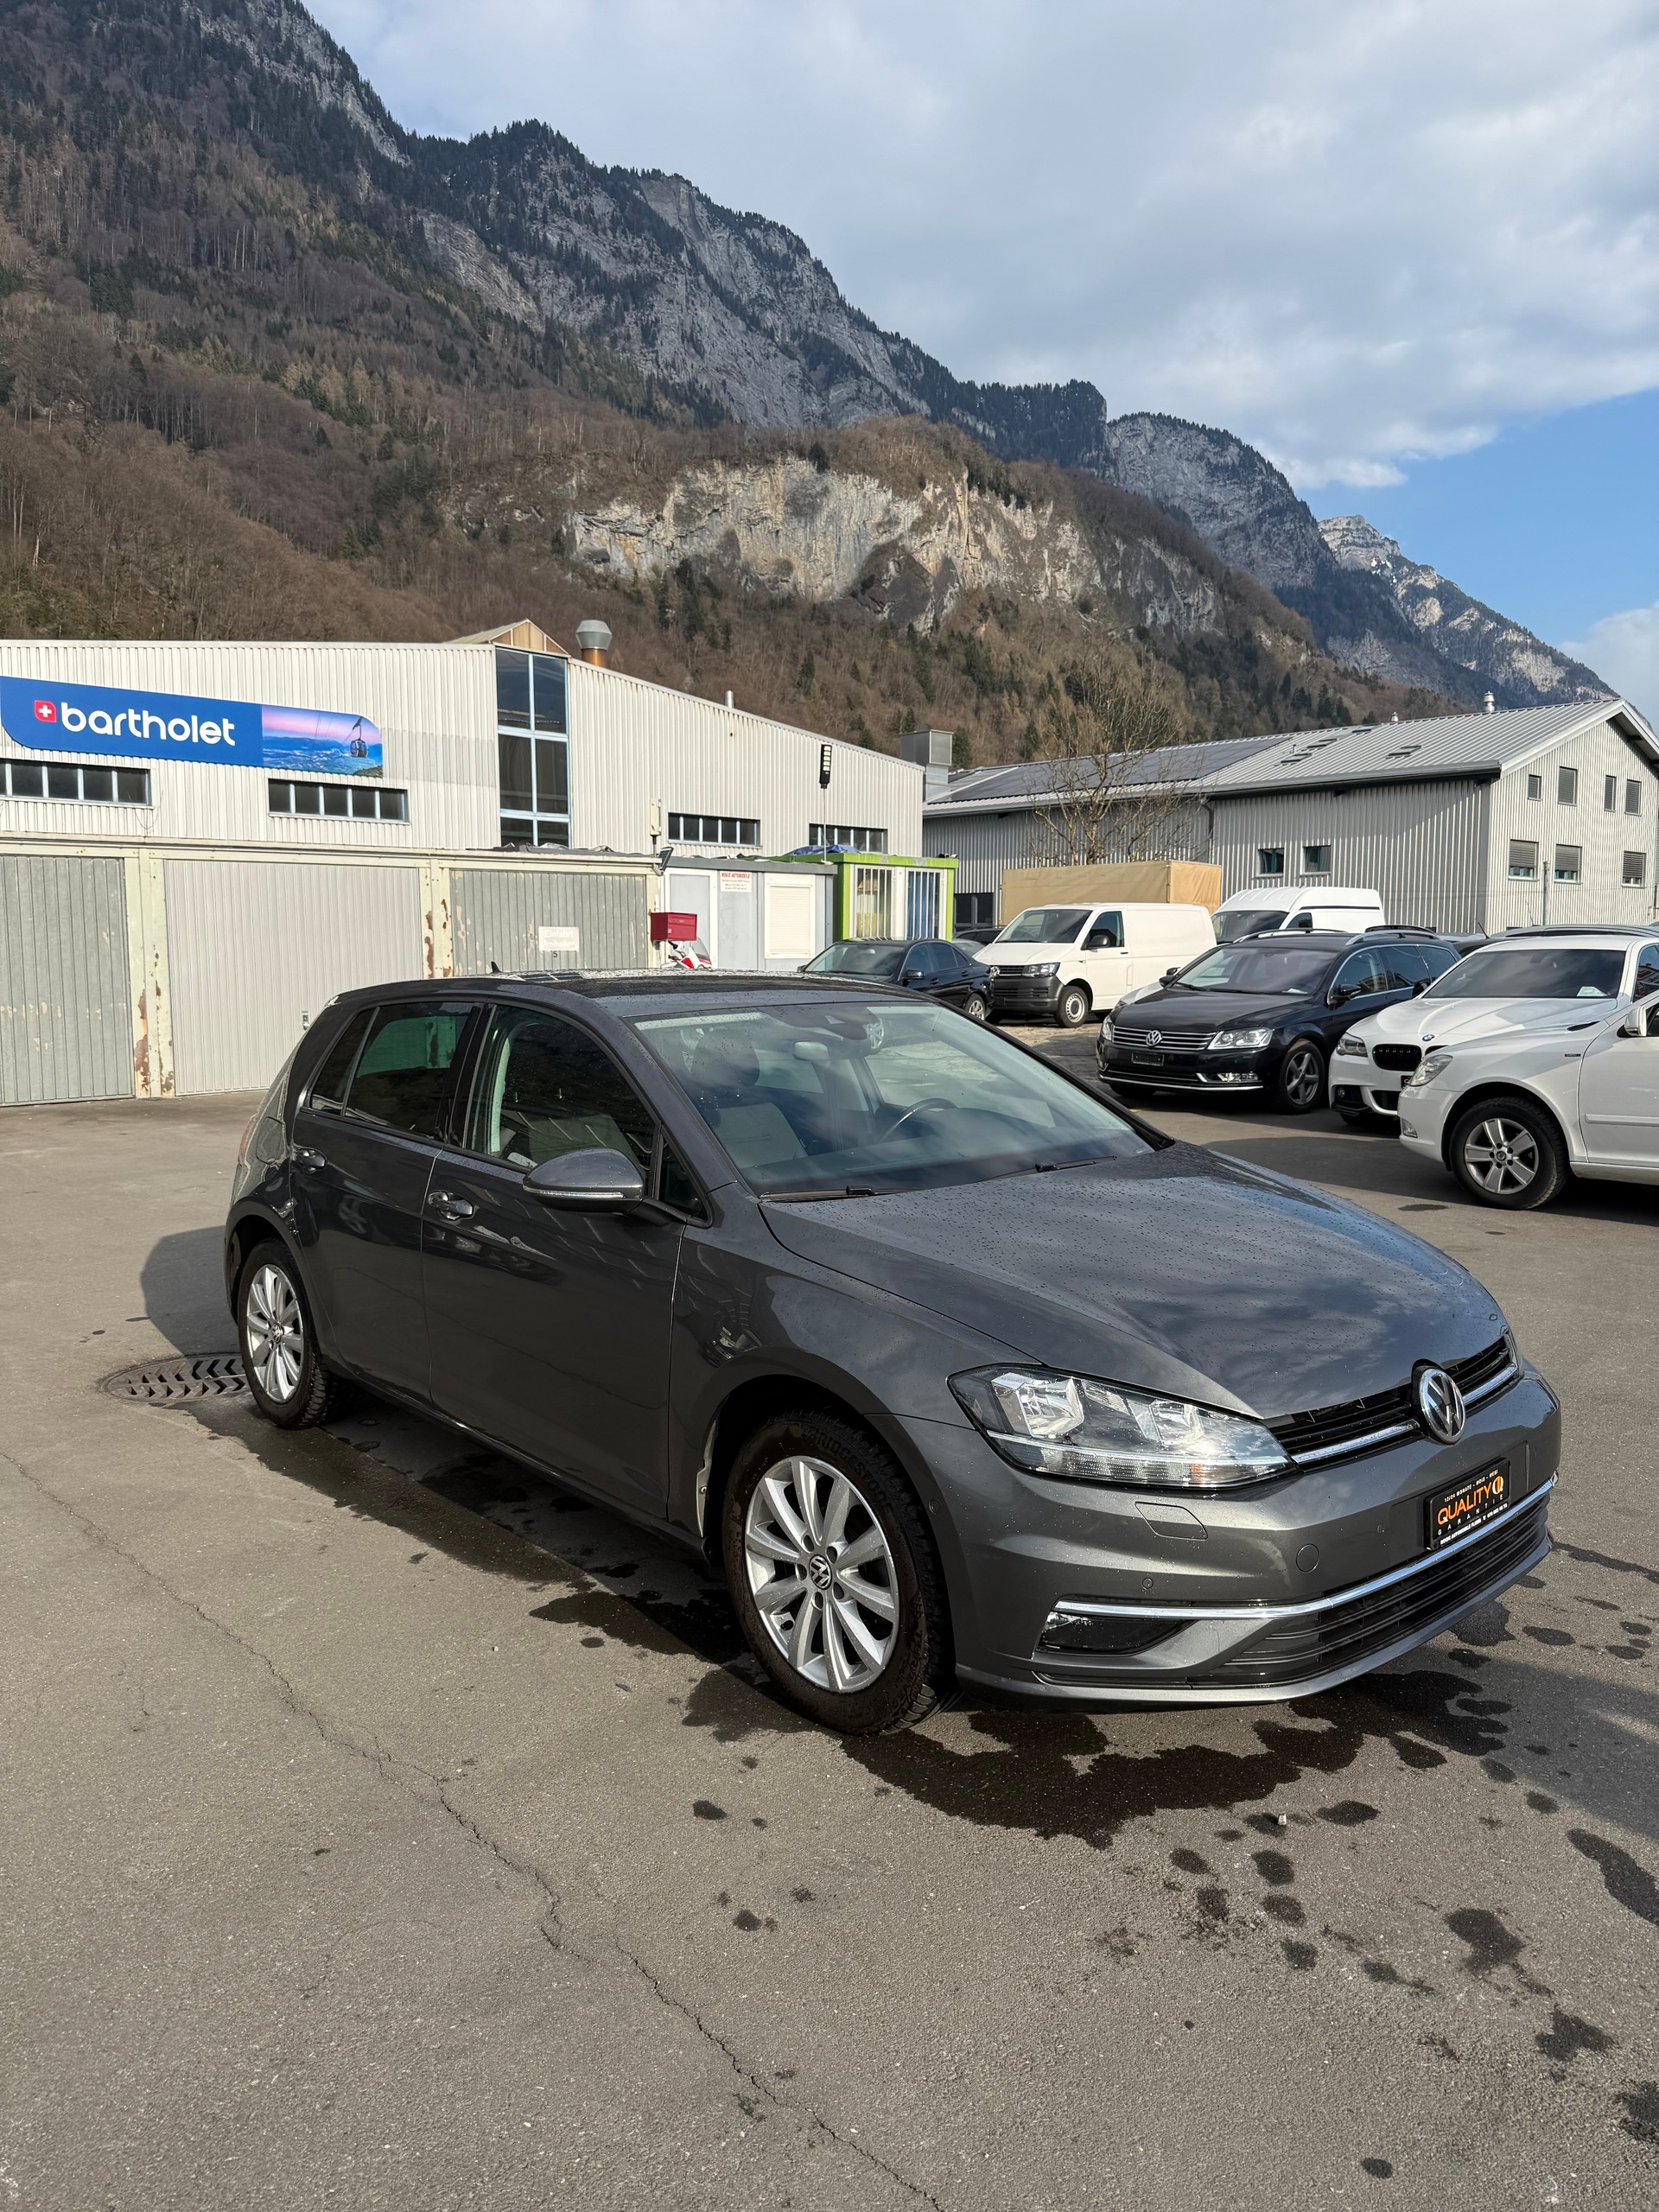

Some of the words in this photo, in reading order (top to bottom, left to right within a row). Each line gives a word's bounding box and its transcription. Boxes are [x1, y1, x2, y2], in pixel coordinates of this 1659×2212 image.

[61, 702, 235, 747] bartholet
[1437, 1481, 1492, 1525] QUALITY
[1437, 1494, 1503, 1535] GARANTIE
